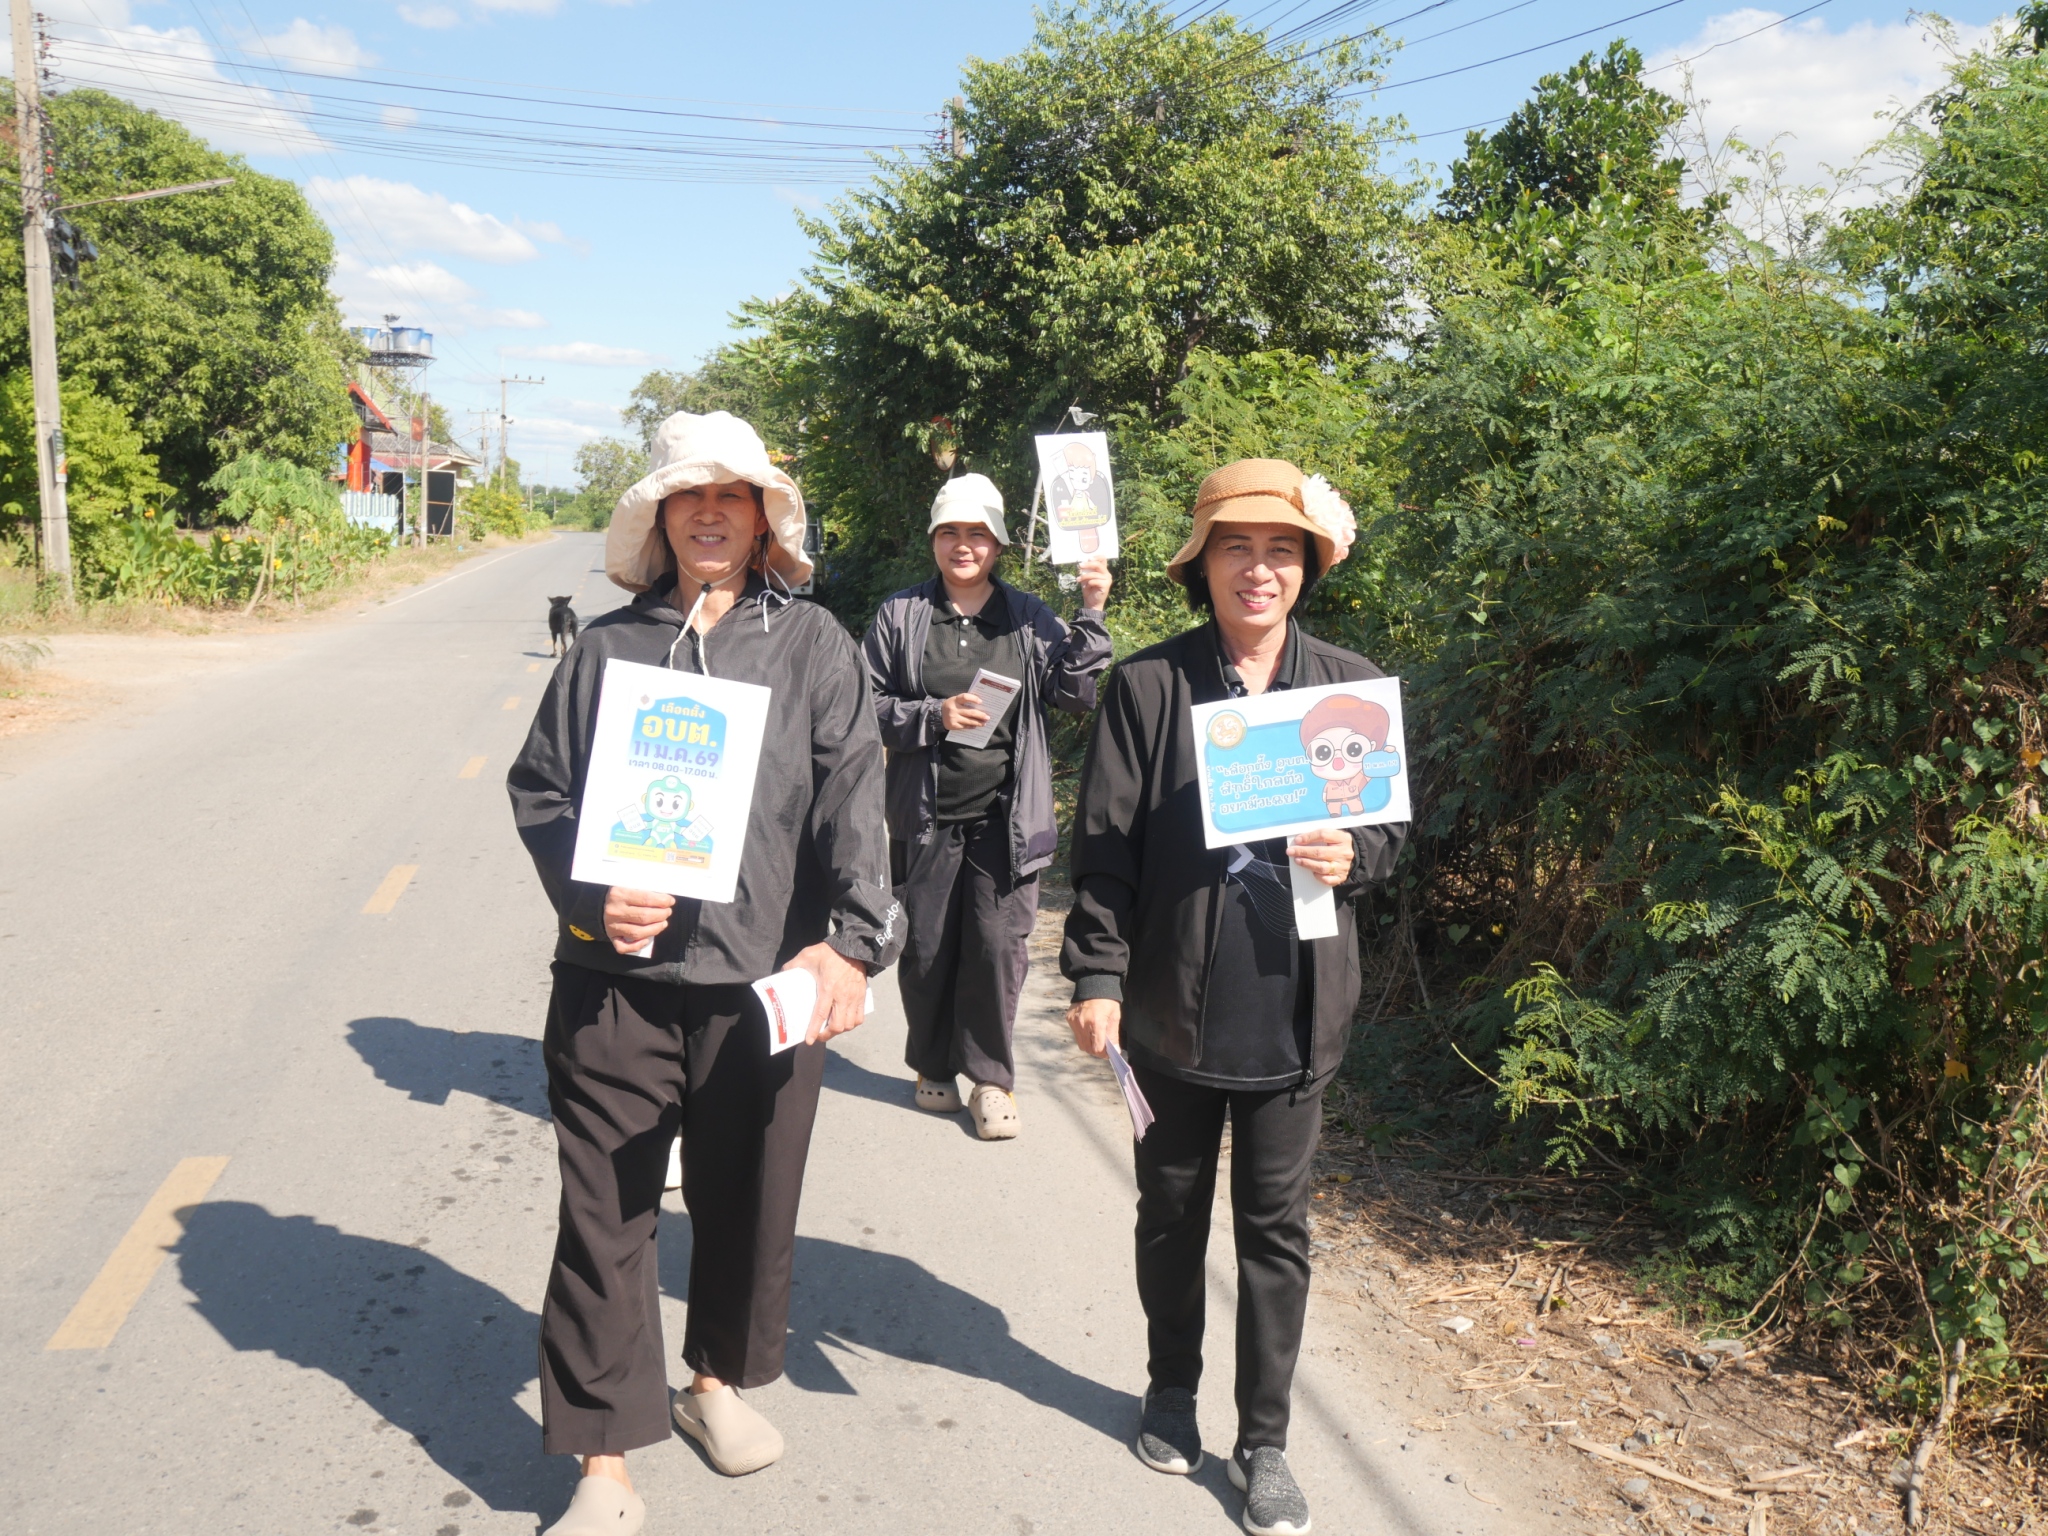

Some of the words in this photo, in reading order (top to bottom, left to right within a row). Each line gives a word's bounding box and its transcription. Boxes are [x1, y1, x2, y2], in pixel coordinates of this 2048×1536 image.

[661, 702, 706, 719] เลือกตั้ง
[642, 715, 718, 748] อบต.
[628, 759, 650, 769] เวลา
[634, 740, 651, 757] 11
[653, 743, 693, 764] ม.ค.
[695, 750, 719, 768] 69
